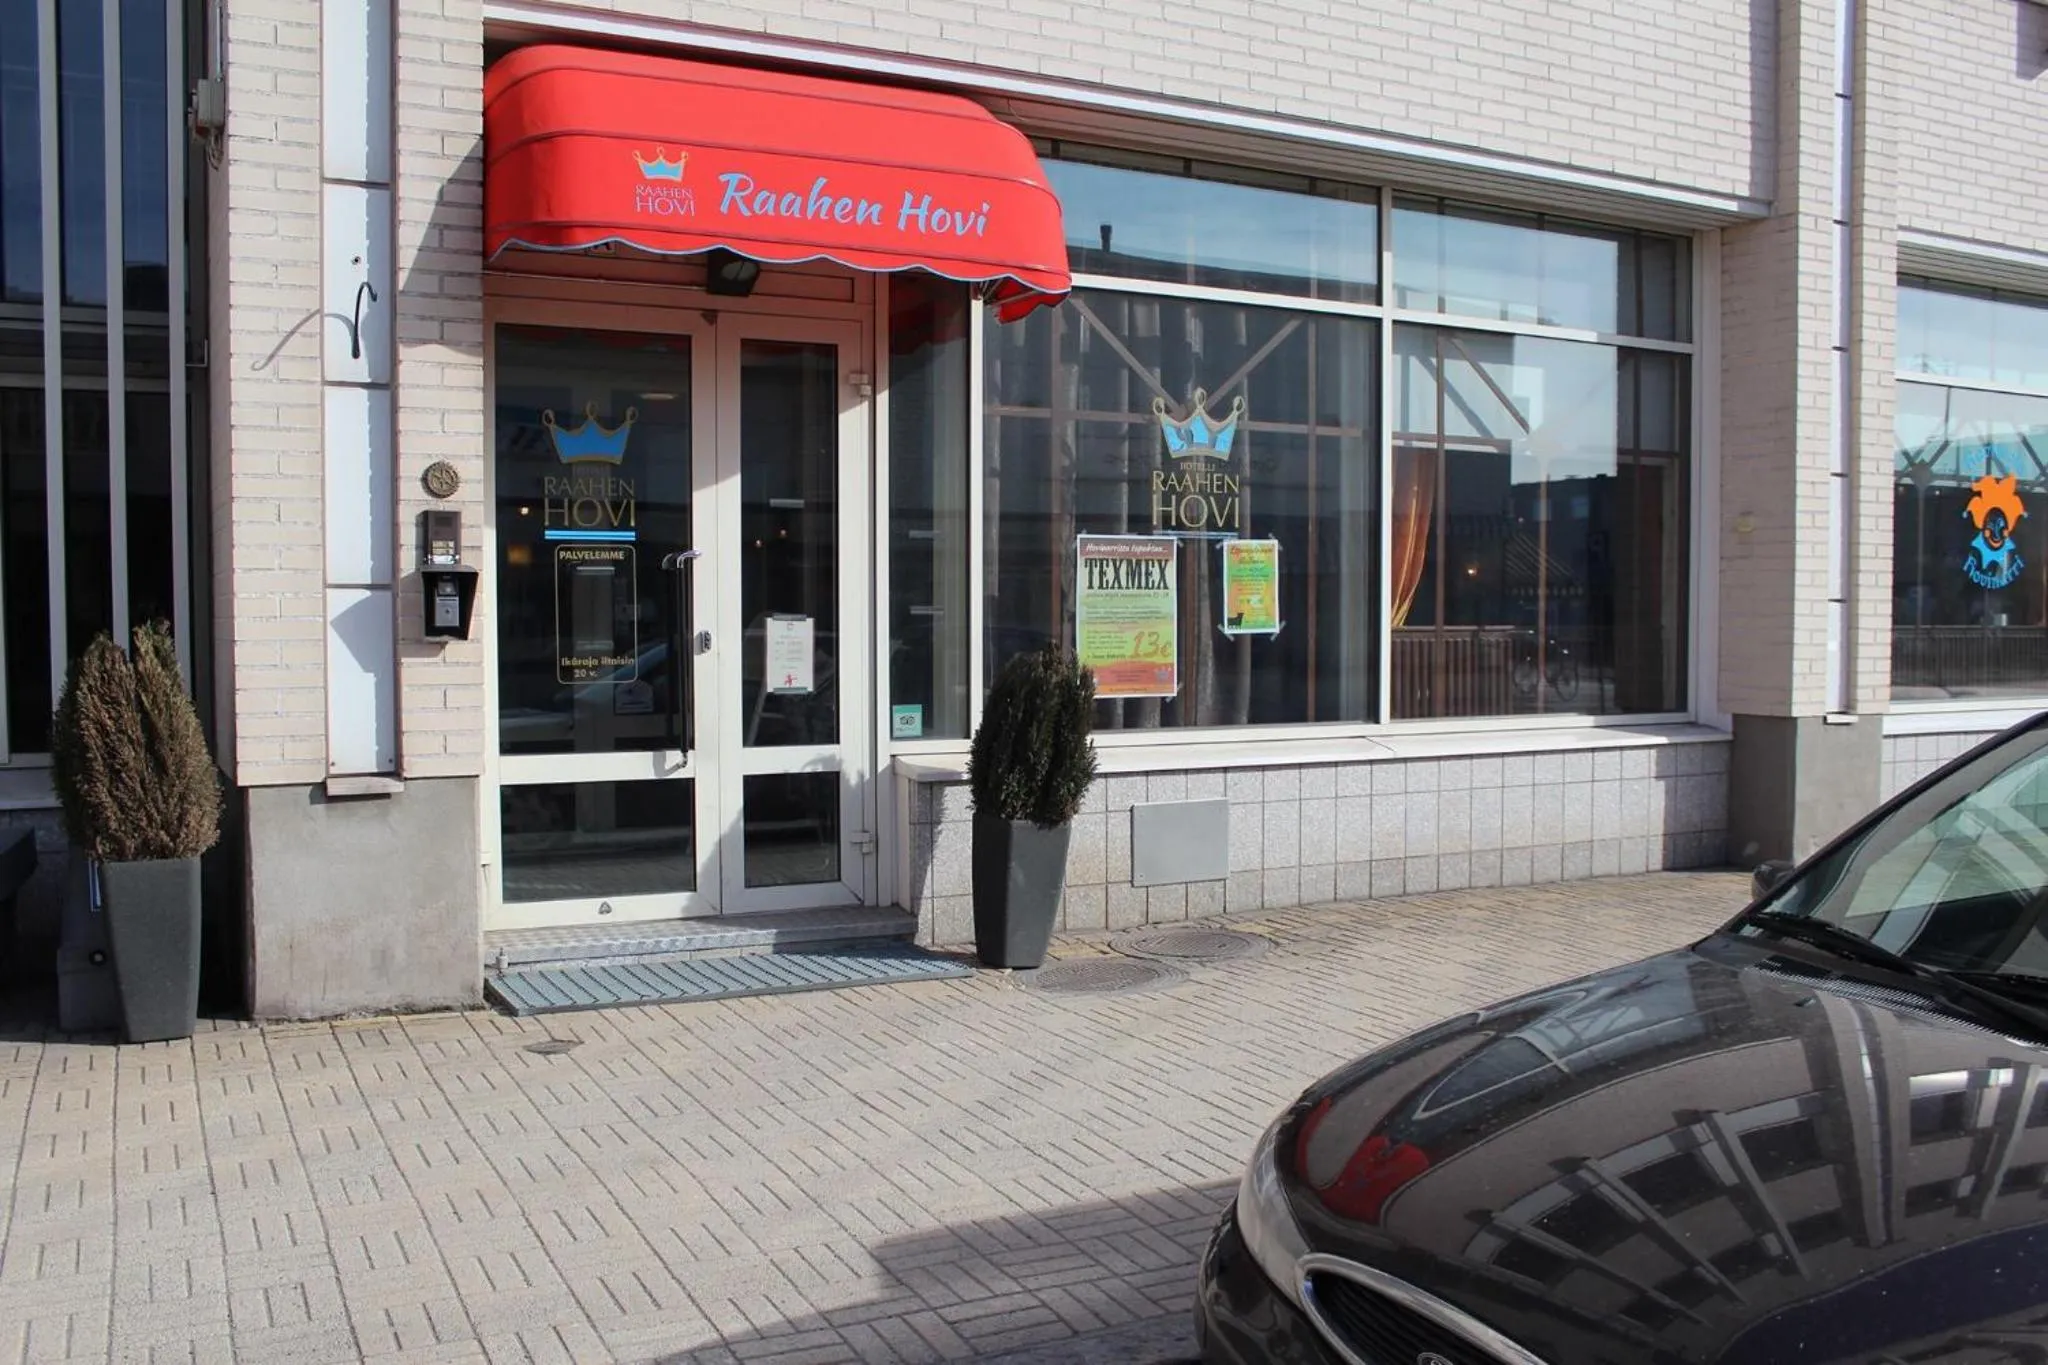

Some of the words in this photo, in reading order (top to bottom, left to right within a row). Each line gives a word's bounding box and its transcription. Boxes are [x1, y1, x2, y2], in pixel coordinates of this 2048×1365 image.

[635, 184, 694, 199] RAAHEN
[636, 196, 695, 217] HOVI
[717, 172, 883, 227] Raahen
[897, 190, 990, 238] Hovi
[544, 476, 635, 497] RAAHEN
[1152, 470, 1240, 494] RAAHEN
[544, 497, 635, 527] HOVI
[1152, 494, 1240, 529] HOVI
[559, 550, 625, 560] PALVELEMME
[1084, 557, 1169, 590] TEXMEX
